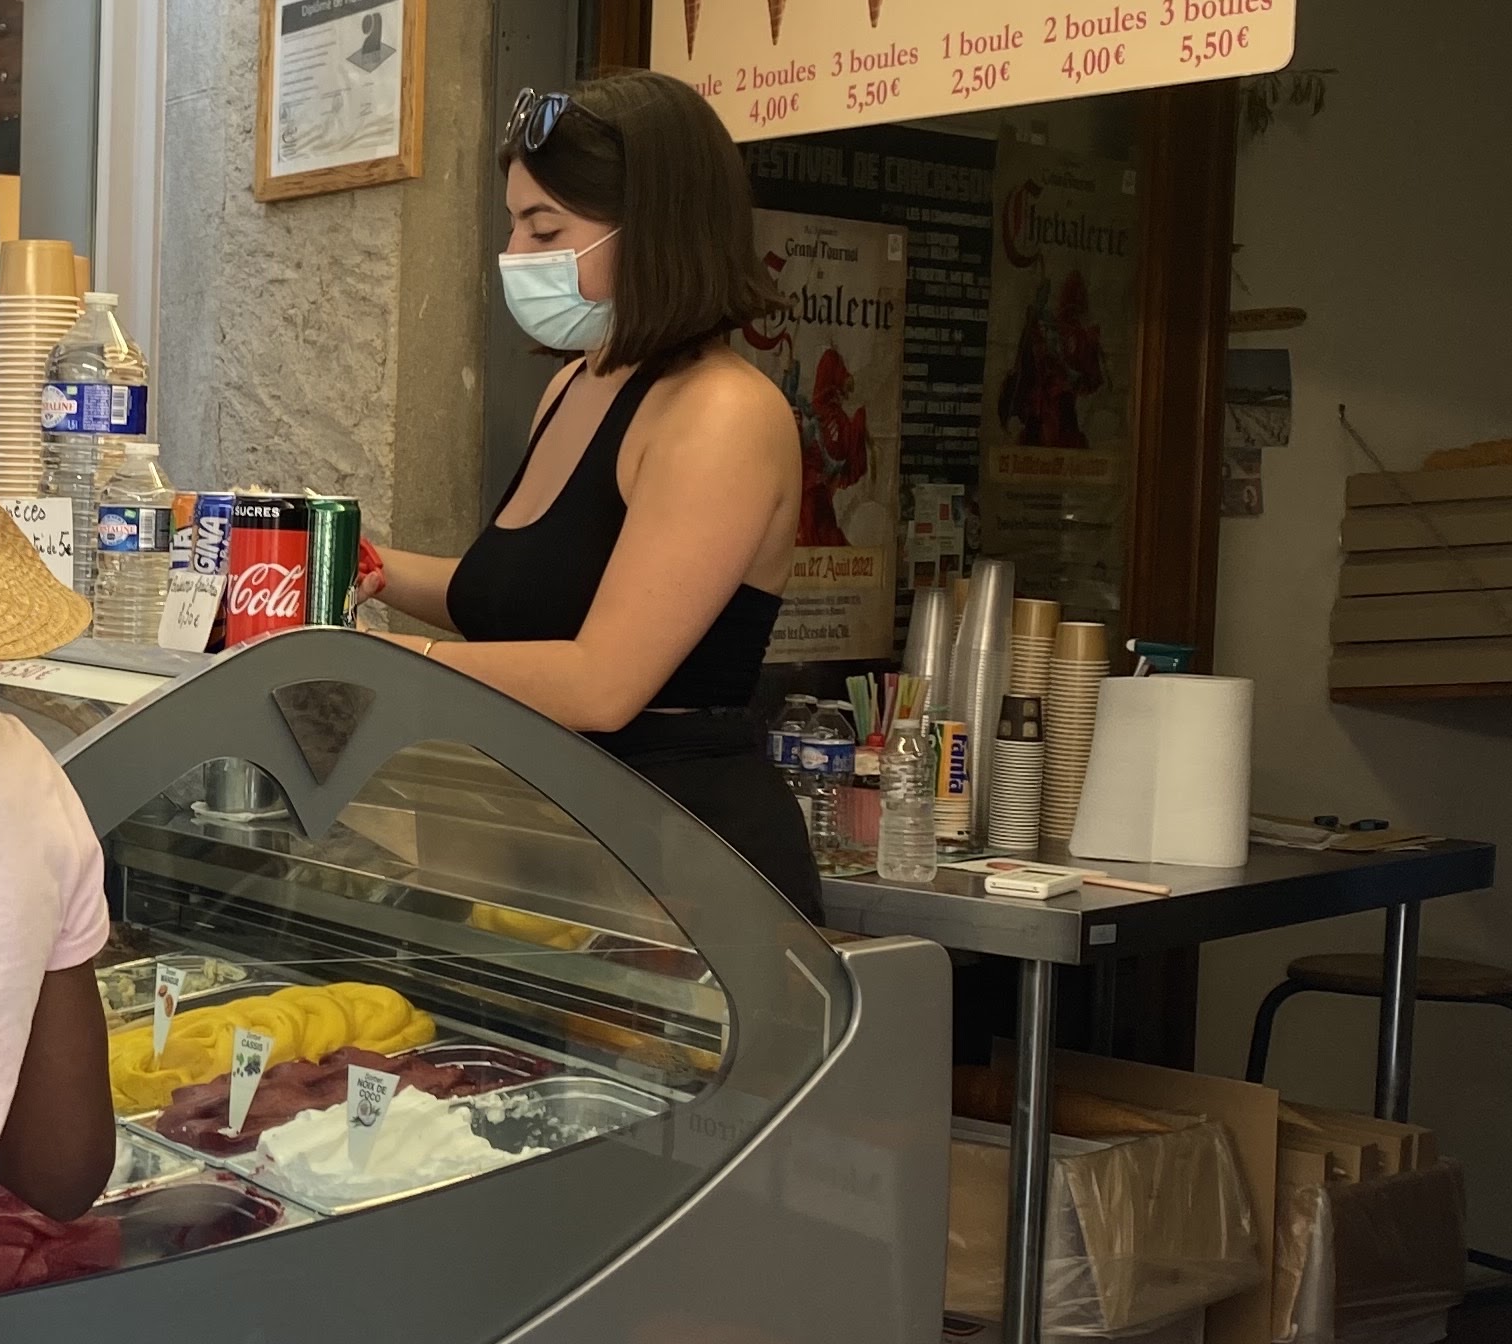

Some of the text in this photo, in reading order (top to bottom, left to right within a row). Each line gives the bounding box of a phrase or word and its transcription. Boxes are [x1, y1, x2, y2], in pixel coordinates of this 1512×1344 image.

[941, 24, 1024, 59] 1 boule
[1044, 6, 1147, 44] 2 boules
[831, 42, 919, 77] 3 boules
[1061, 43, 1126, 85] 4,00€
[1180, 25, 1249, 68] 5,50€
[696, 74, 723, 99] ule
[735, 60, 817, 93] 2 boules
[951, 61, 1011, 100] 2,50€
[749, 92, 800, 128] 4,00€
[846, 77, 901, 114] 5,50€
[785, 238, 818, 258] Grand
[234, 505, 281, 518] SUCRES
[194, 517, 229, 575] GINA
[808, 556, 823, 576] 27
[851, 556, 874, 576] 2021
[230, 562, 306, 618] Cola
[241, 1039, 264, 1051] CASSIS
[357, 1078, 388, 1095] NOIX DE
[359, 1088, 381, 1102] COCO
